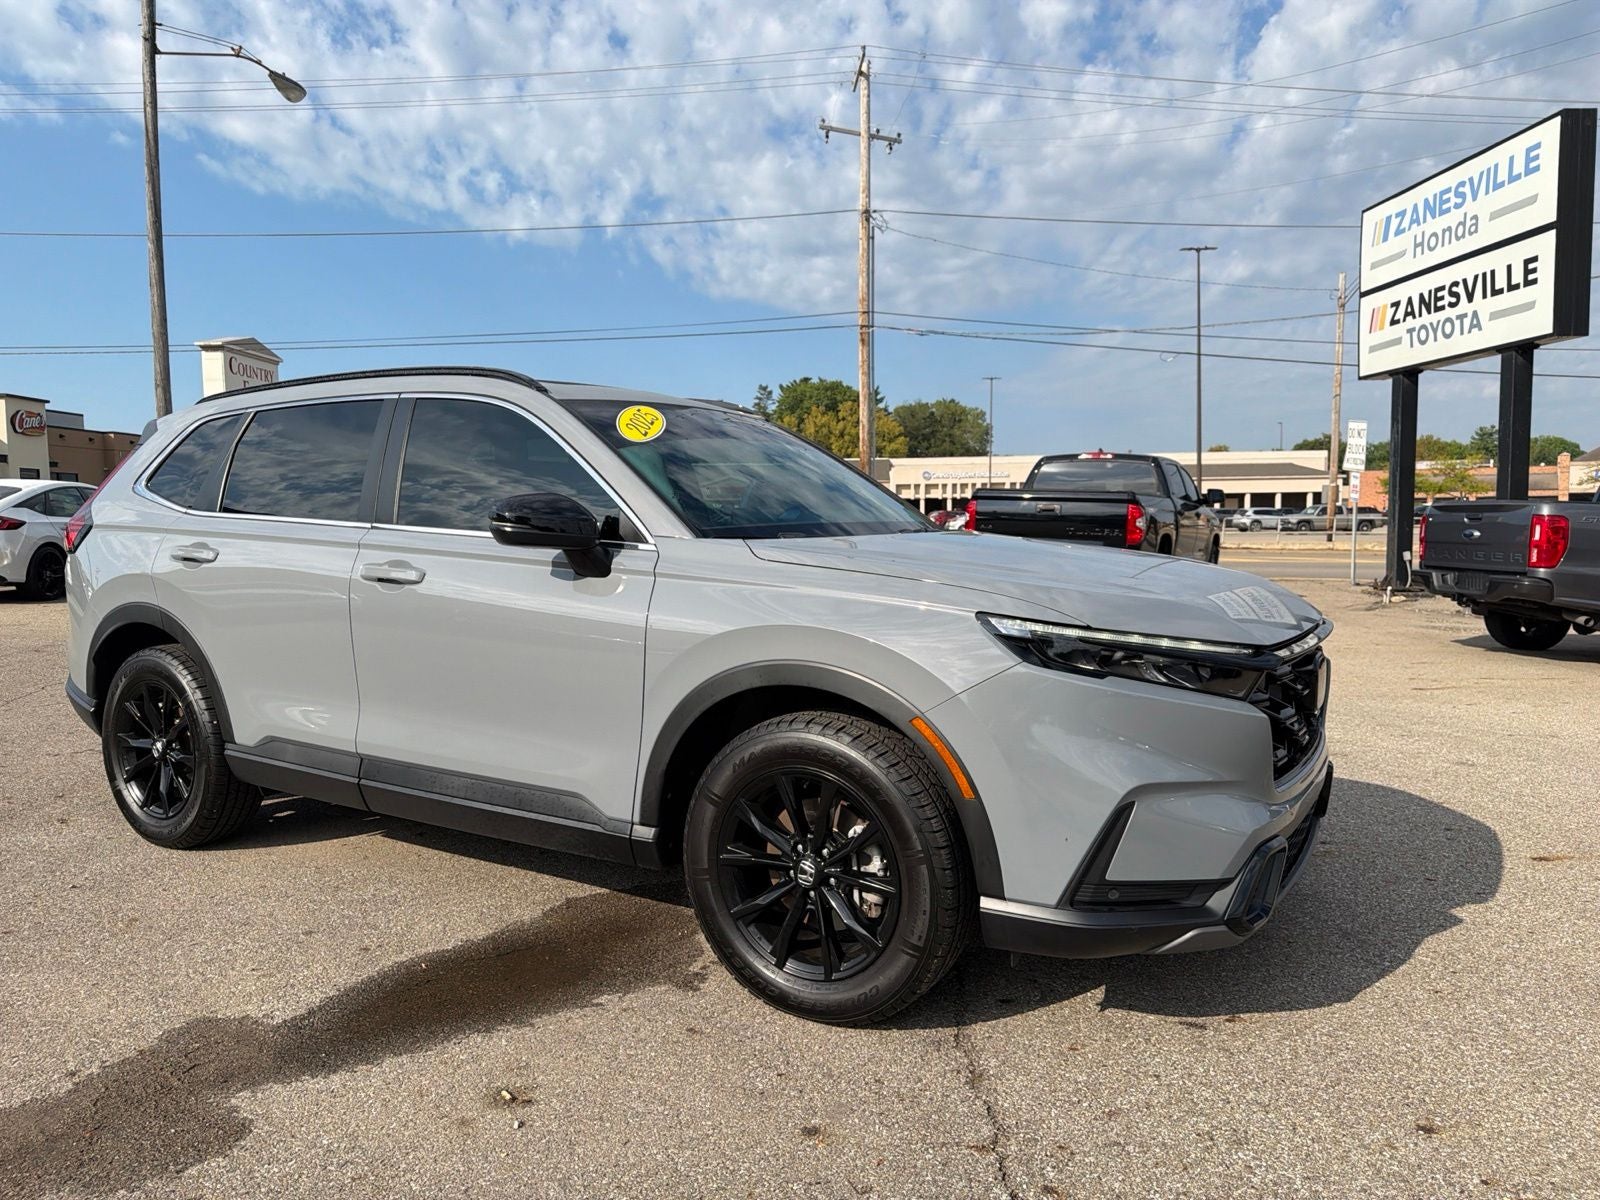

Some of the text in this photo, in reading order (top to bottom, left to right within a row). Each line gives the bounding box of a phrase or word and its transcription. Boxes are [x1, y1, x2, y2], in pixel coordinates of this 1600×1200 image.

[1394, 141, 1542, 237] ZANESVILLE
[1413, 212, 1479, 259] Honda
[1389, 255, 1539, 326] ZANESVILLE
[1406, 309, 1483, 348] TOYOTA
[15, 410, 46, 433] Cane's
[625, 408, 659, 437] 2025
